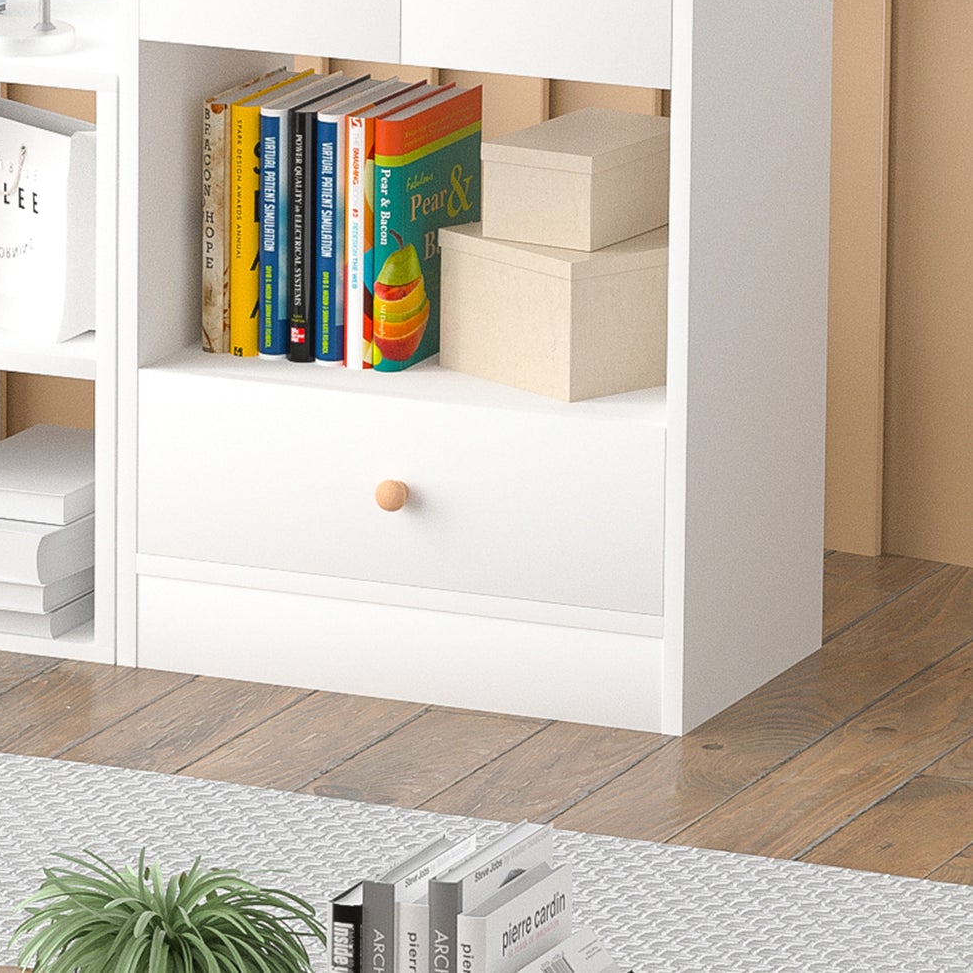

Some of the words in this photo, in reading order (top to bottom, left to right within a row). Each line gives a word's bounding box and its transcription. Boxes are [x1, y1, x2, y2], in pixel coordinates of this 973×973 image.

[264, 136, 276, 169] VIRTUAL
[295, 134, 303, 164] POWER
[322, 142, 333, 174] VIRTUAL
[264, 171, 276, 203] PATIENT
[294, 166, 303, 204] QUALITY
[321, 176, 333, 209] PATIENT
[381, 169, 391, 195] Pear
[410, 189, 447, 222] Pear
[263, 204, 276, 252] SIMULATION
[294, 214, 303, 264] ELECTRICAL
[321, 210, 333, 258] SIMULATION
[380, 211, 390, 245] Bacon
[294, 267, 302, 306] SYSTEMS
[502, 915, 532, 957] pierre
[534, 891, 566, 928] cardin
